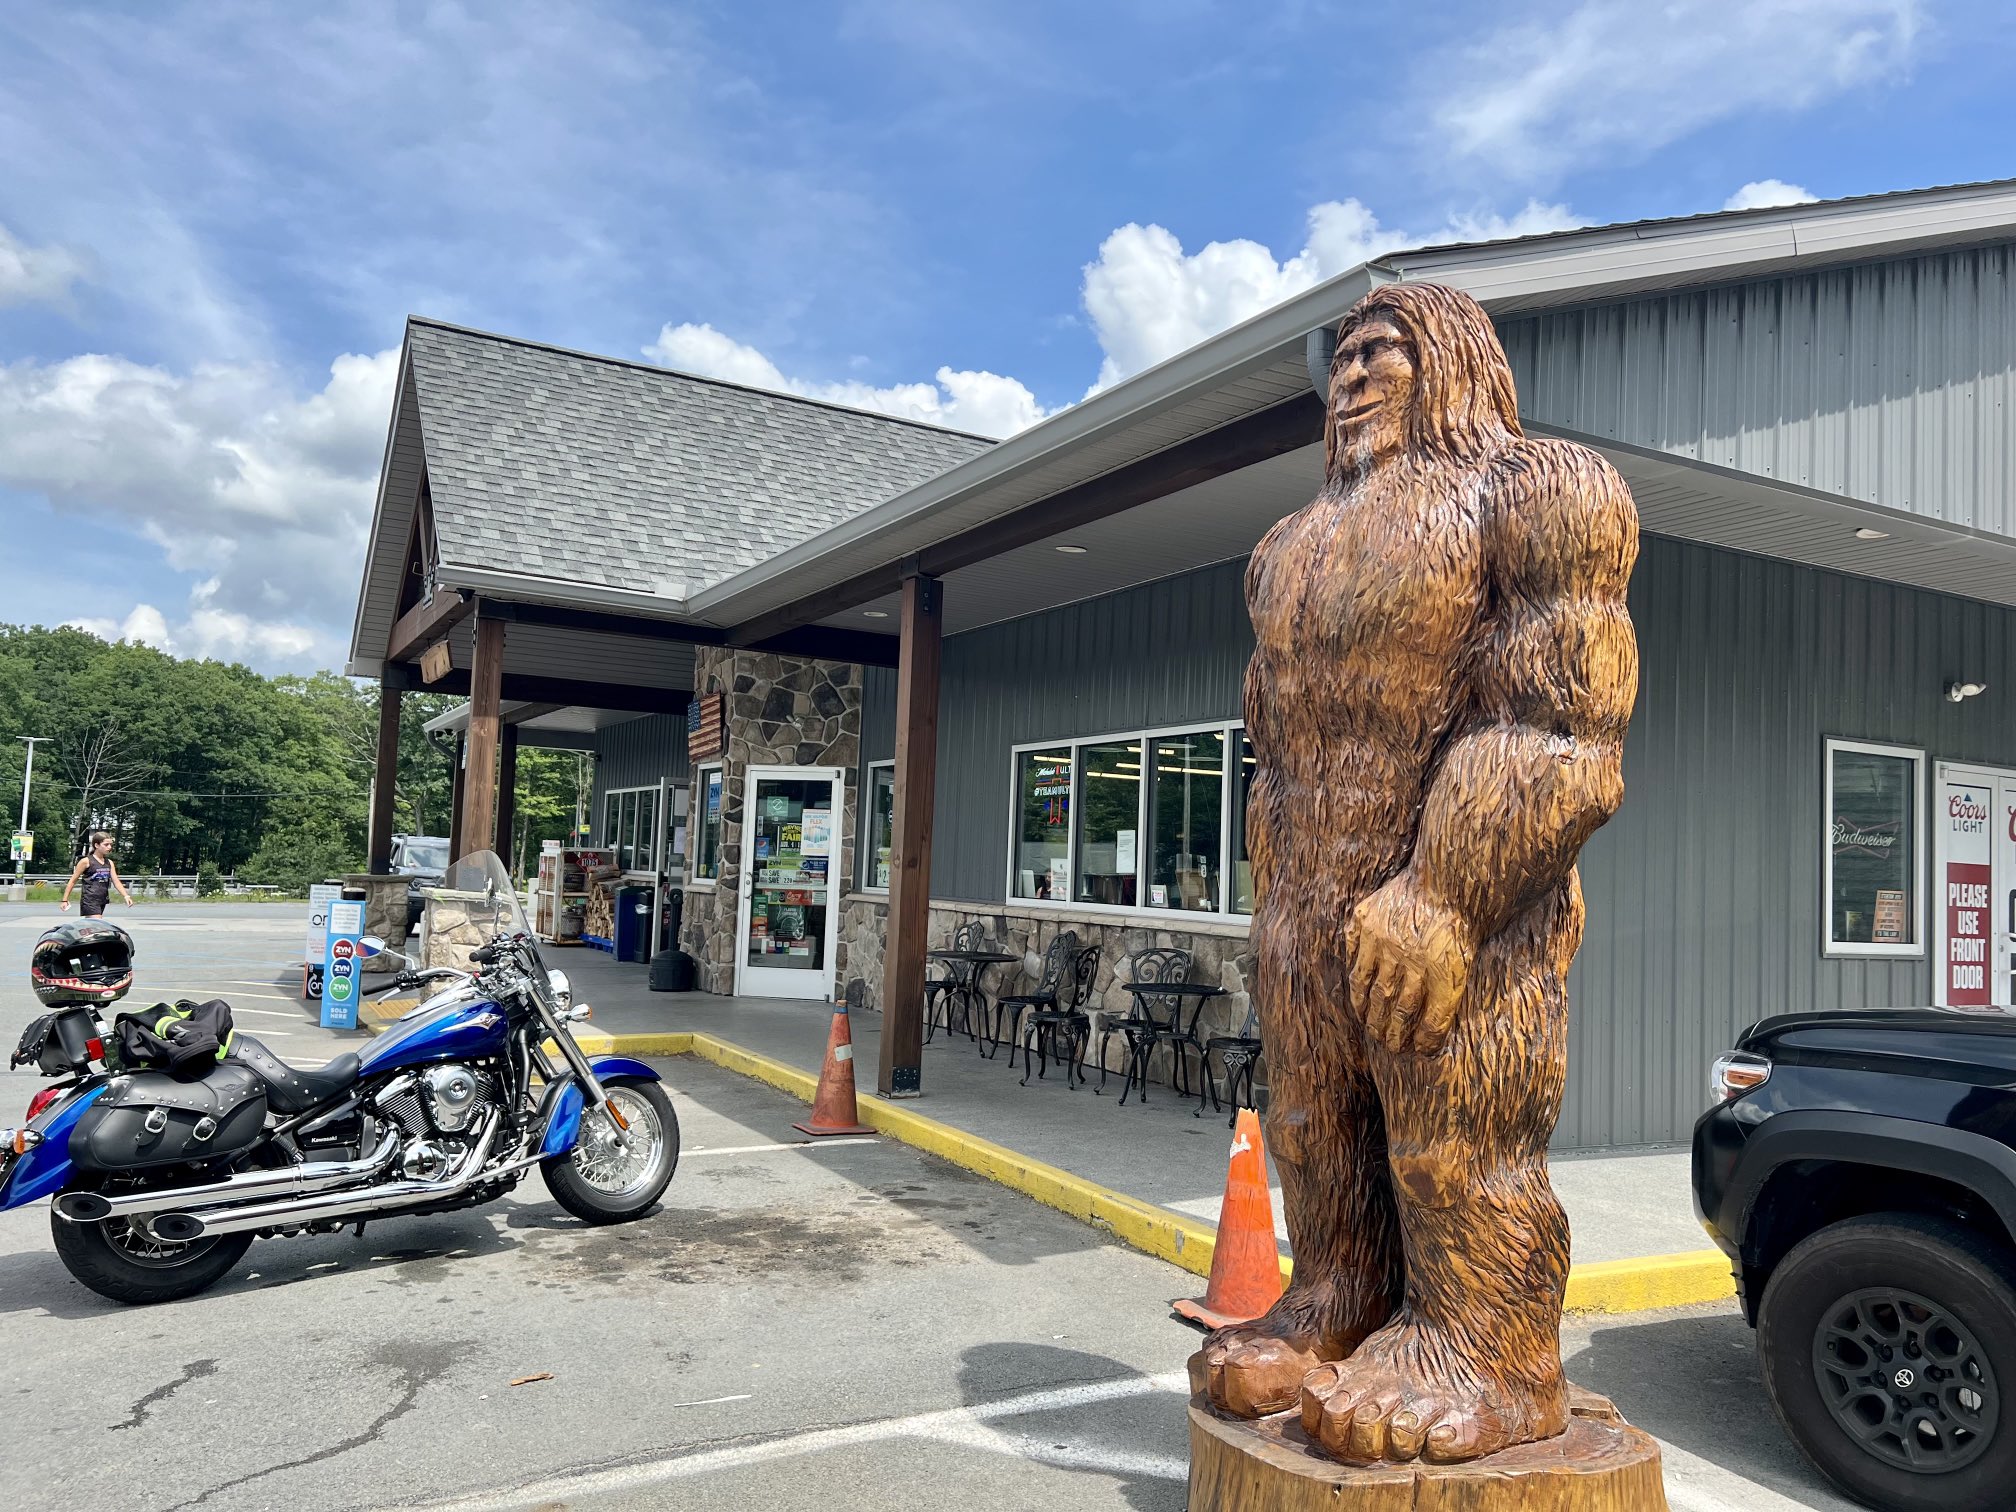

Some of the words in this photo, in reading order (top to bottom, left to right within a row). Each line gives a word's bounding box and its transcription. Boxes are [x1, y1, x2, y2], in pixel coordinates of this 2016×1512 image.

[1060, 765, 1072, 774] ULT
[1949, 795, 1987, 820] Coors
[1832, 823, 1896, 847] Budweiser
[1953, 819, 1983, 833] LIGHT
[1949, 882, 1988, 908] PLEASE
[1958, 910, 1979, 935] USE
[1951, 937, 1986, 962] FRONT
[311, 982, 323, 990] on
[1953, 964, 1984, 989] DOOR
